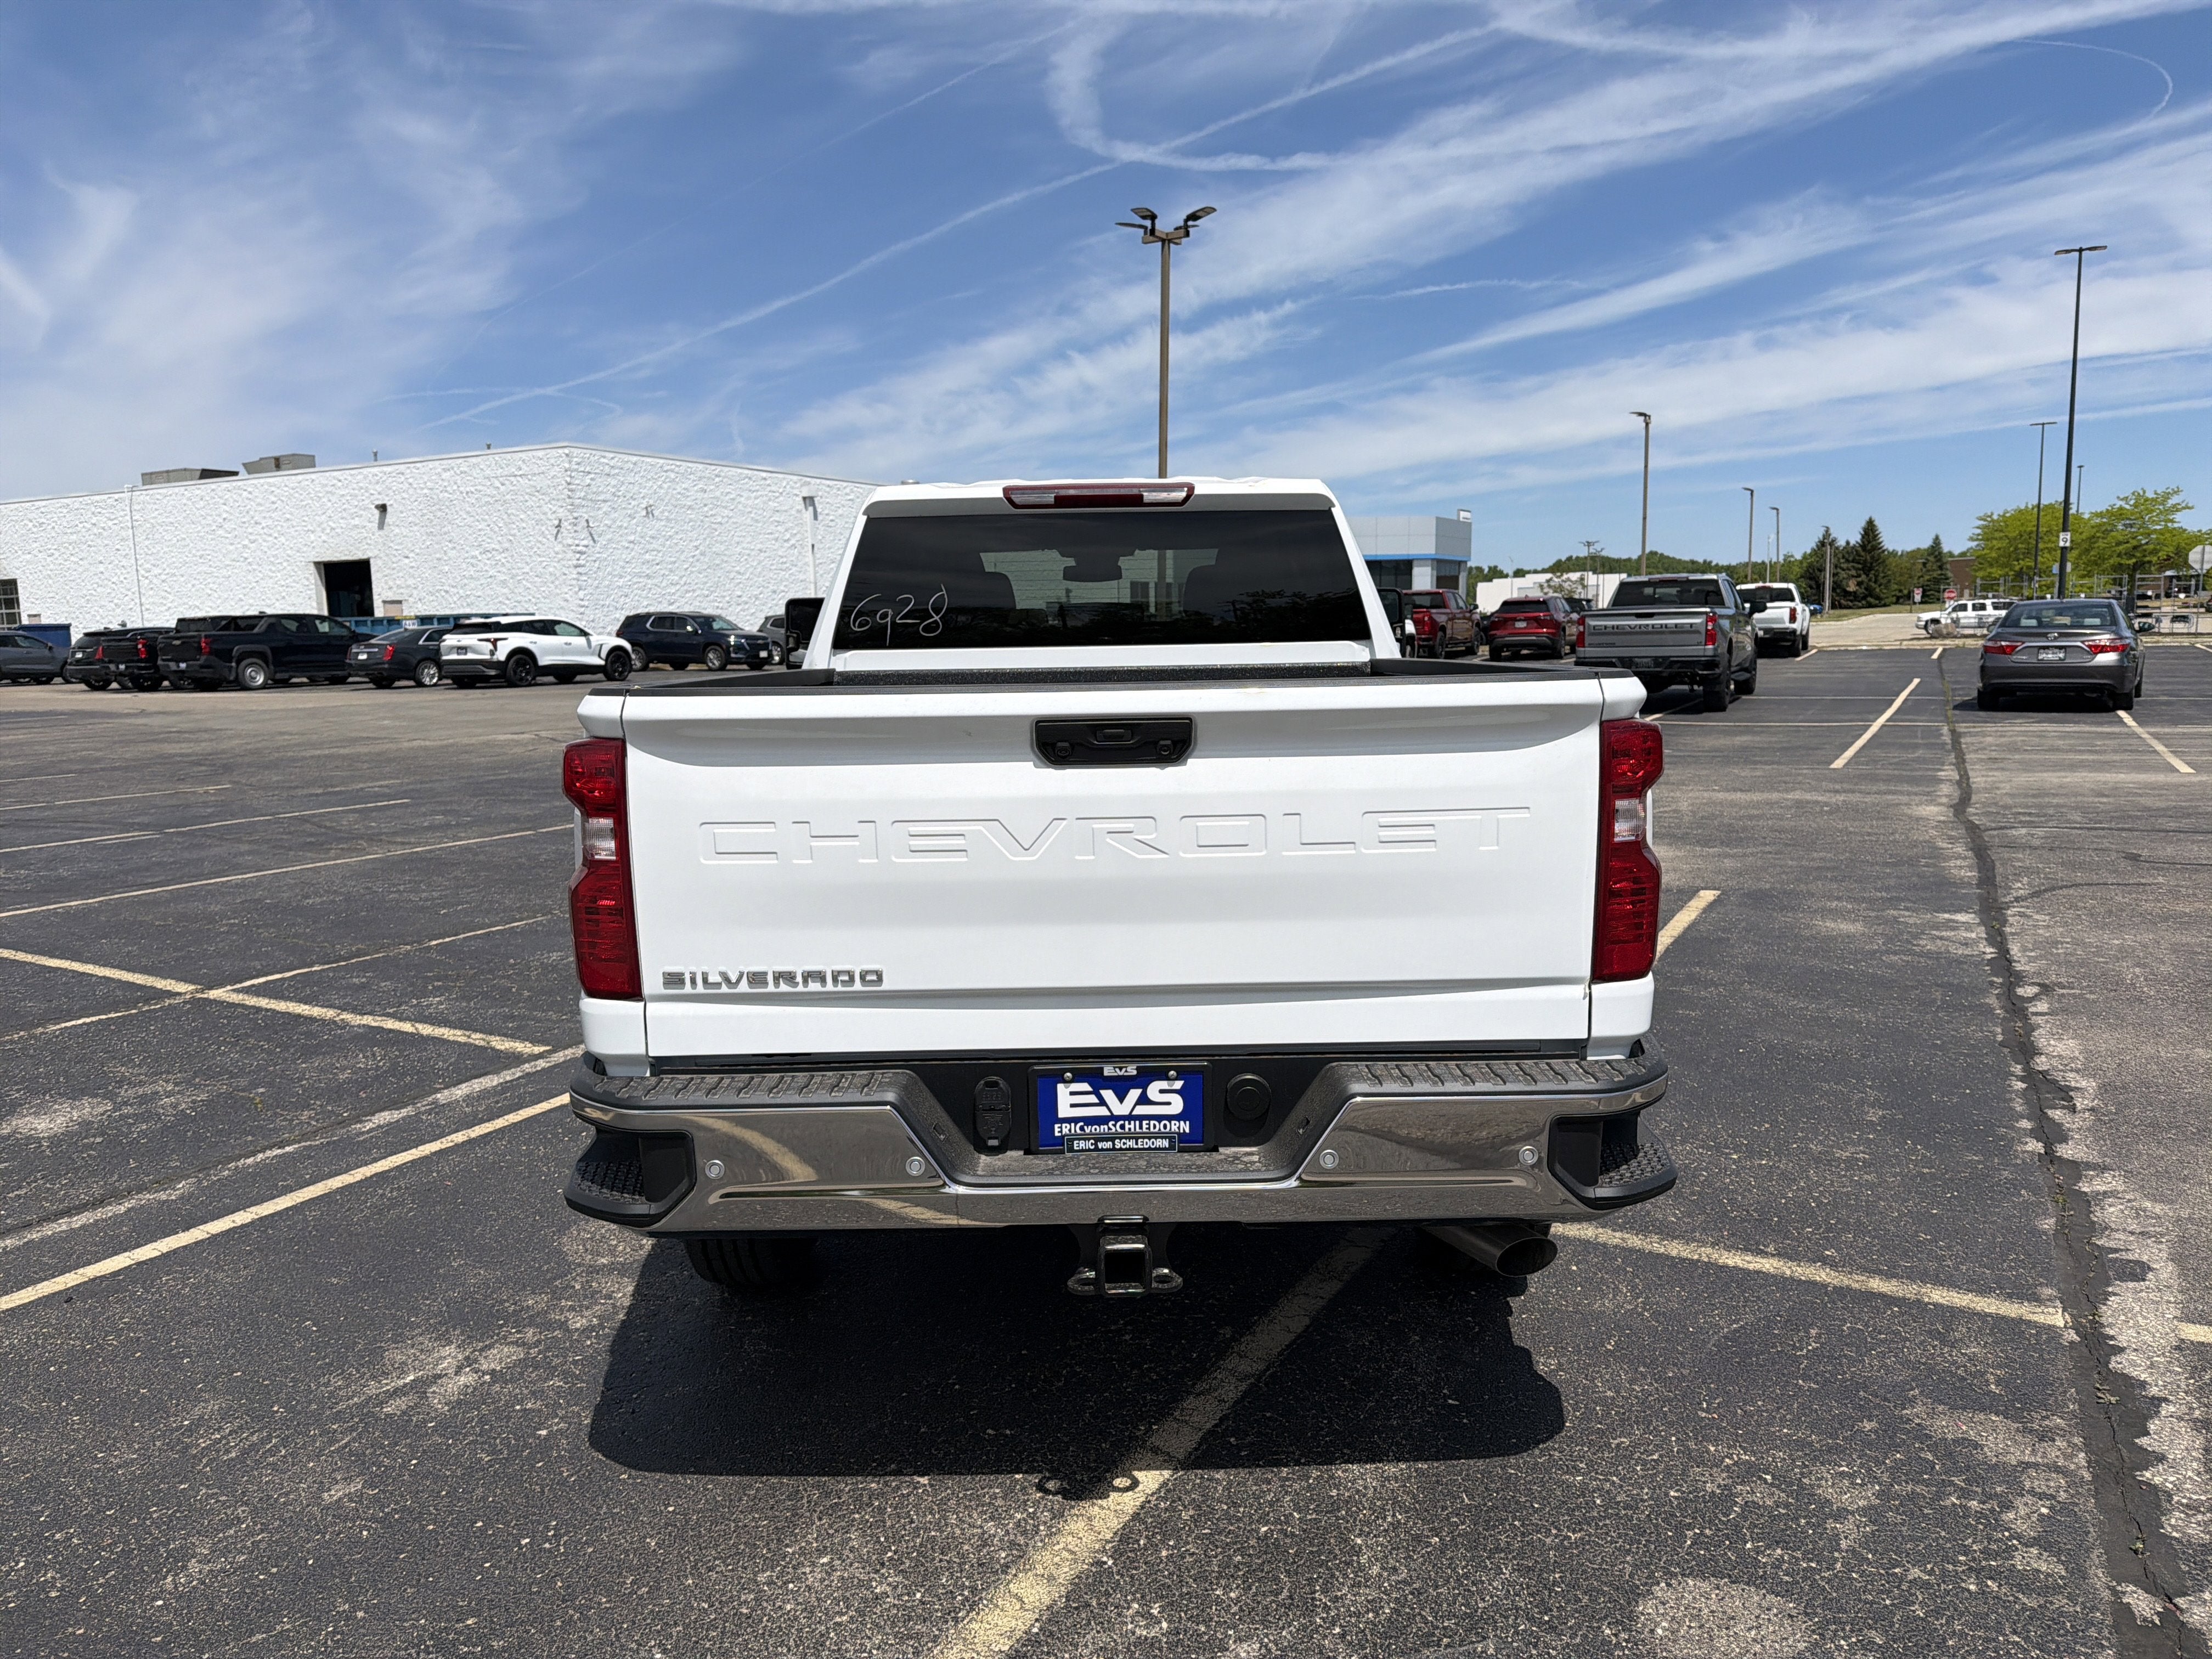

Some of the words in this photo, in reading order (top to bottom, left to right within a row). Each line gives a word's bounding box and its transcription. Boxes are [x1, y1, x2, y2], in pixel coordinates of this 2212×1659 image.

[2062, 537, 2068, 545] 9
[850, 584, 947, 646] 6928
[1593, 623, 1696, 631] CHEVROLET
[699, 807, 1531, 864] CHEVROLET
[662, 968, 883, 990] SILVERADO
[1074, 1139, 1095, 1150] ERIC
[1115, 1138, 1169, 1149] SCHLEDORN
